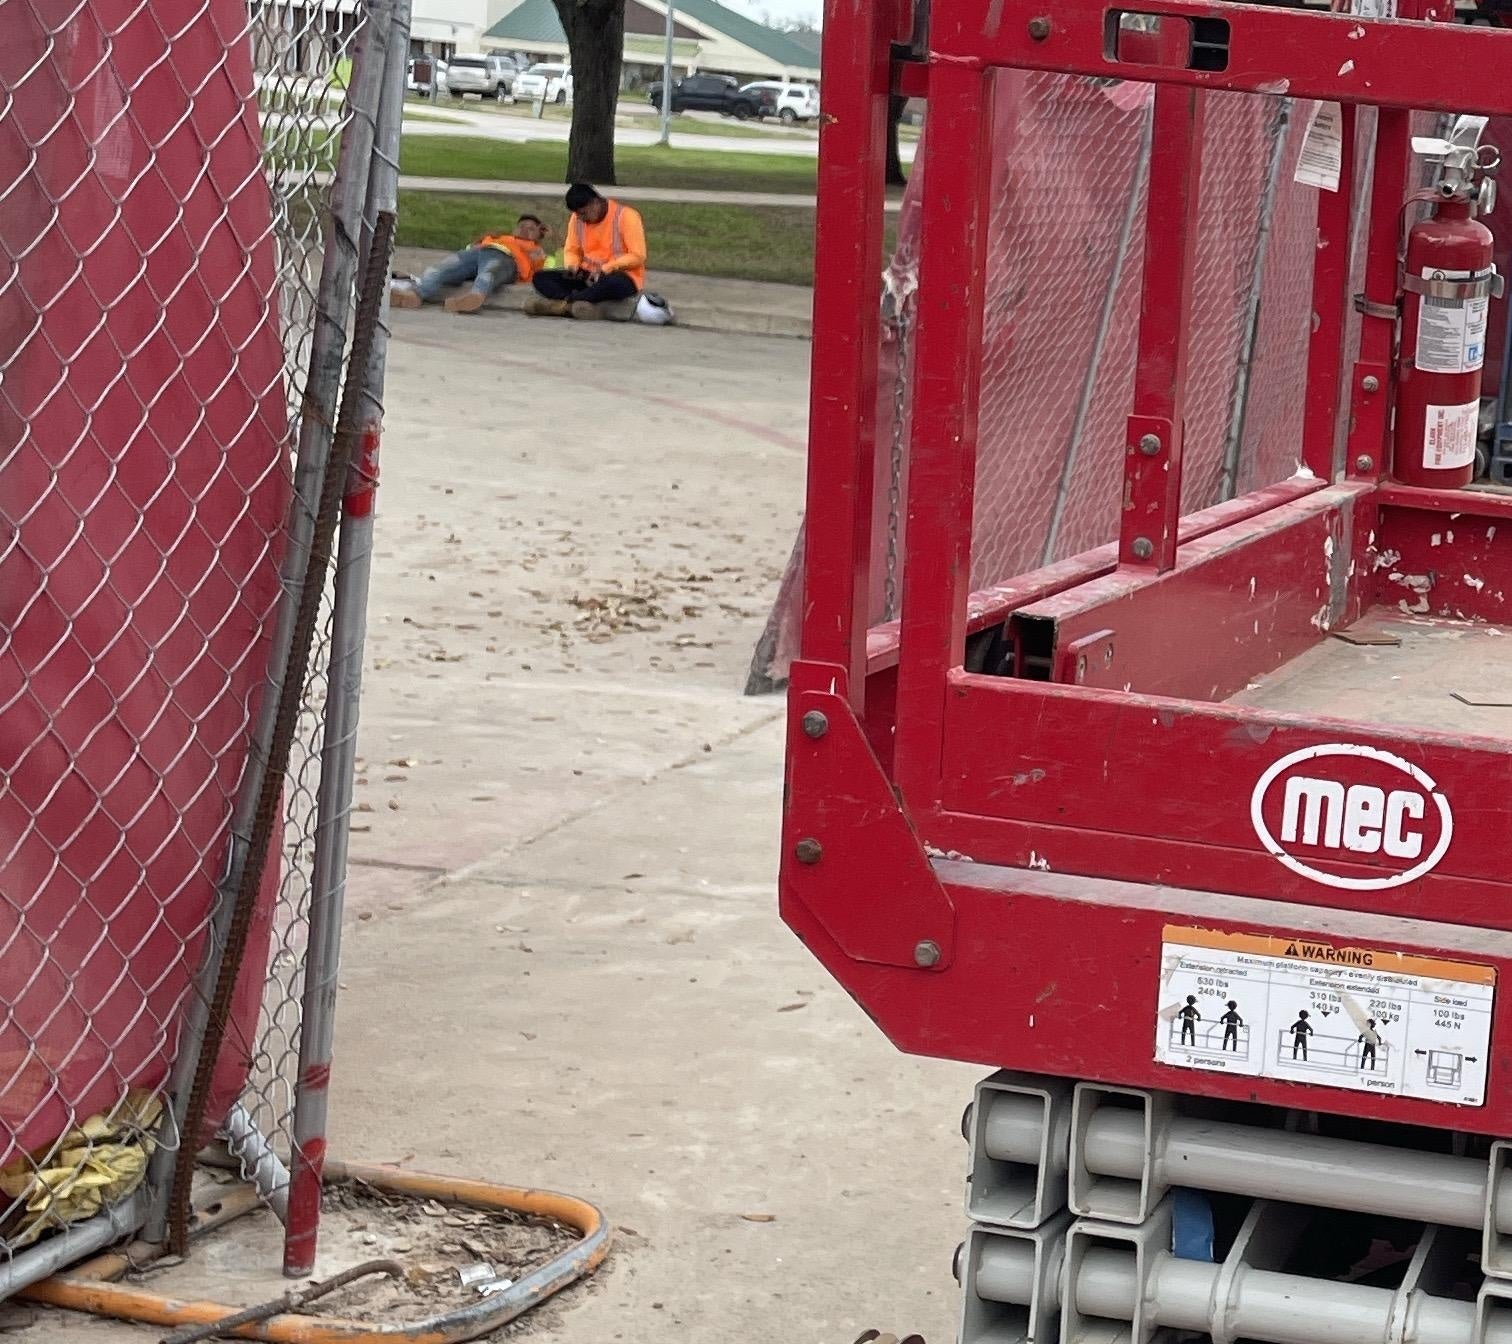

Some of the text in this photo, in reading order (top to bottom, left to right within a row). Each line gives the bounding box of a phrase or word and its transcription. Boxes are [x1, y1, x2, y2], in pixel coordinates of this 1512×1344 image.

[1280, 775, 1426, 860] mec
[1301, 944, 1374, 966] WARNING
[1237, 956, 1275, 968] Maximum
[1309, 978, 1345, 991] Extension
[1197, 986, 1215, 996] 240
[1433, 995, 1451, 1005] Side
[1366, 1078, 1396, 1089] person
